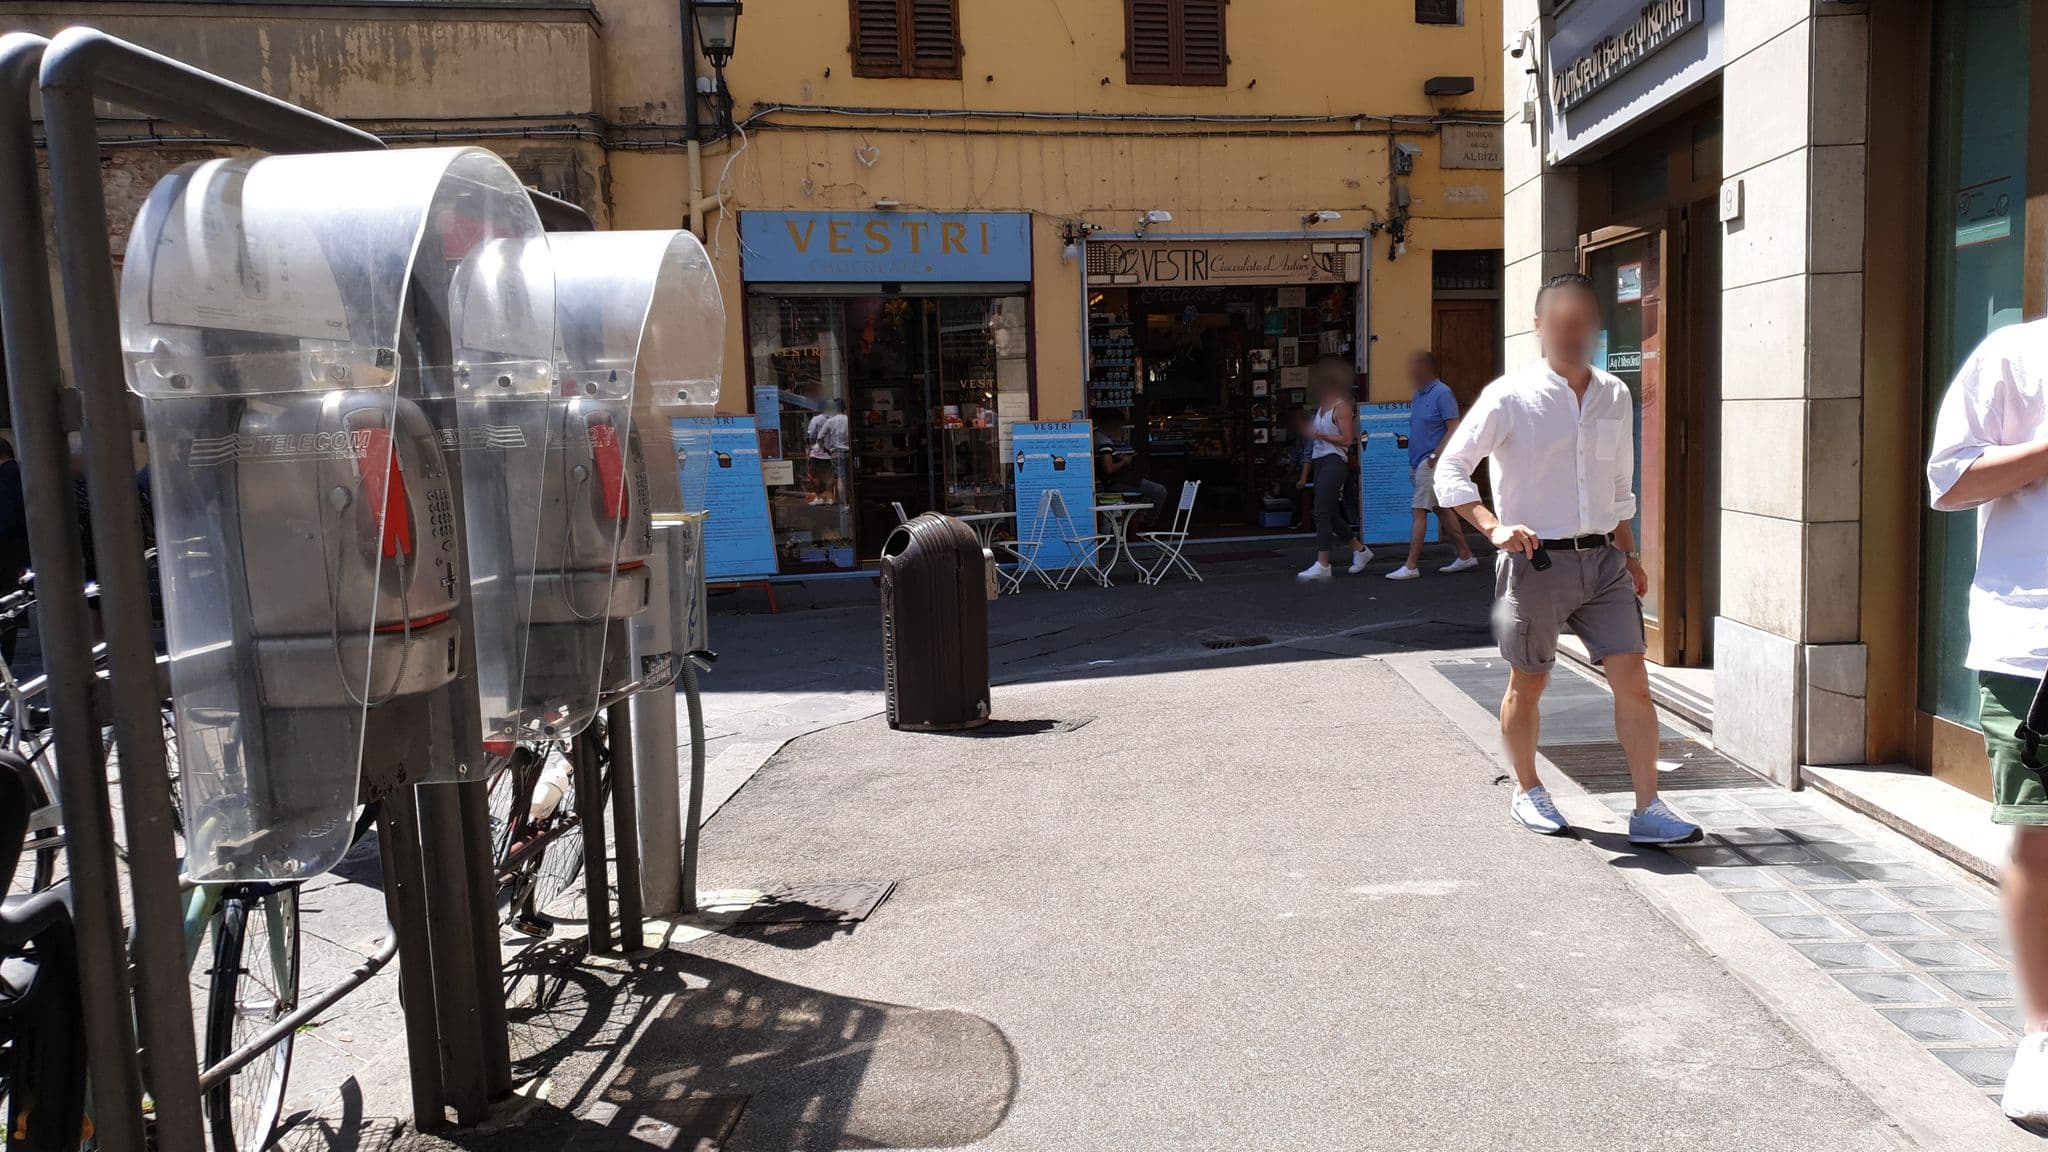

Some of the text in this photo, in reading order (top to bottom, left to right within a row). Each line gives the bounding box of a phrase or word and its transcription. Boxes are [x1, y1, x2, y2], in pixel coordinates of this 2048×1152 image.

[1561, 0, 1684, 97] UniCredit Banca di Roma
[1466, 130, 1494, 138] BORGO
[1463, 152, 1498, 161] ALBIZI
[1725, 189, 1733, 212] 9
[786, 219, 990, 255] VESTRI
[1141, 249, 1209, 282] VESTRI
[1210, 255, 1263, 276] Cioccolato
[1377, 402, 1412, 410] VESTR
[1033, 422, 1072, 431] VESTRI
[256, 430, 373, 455] TELECOM
